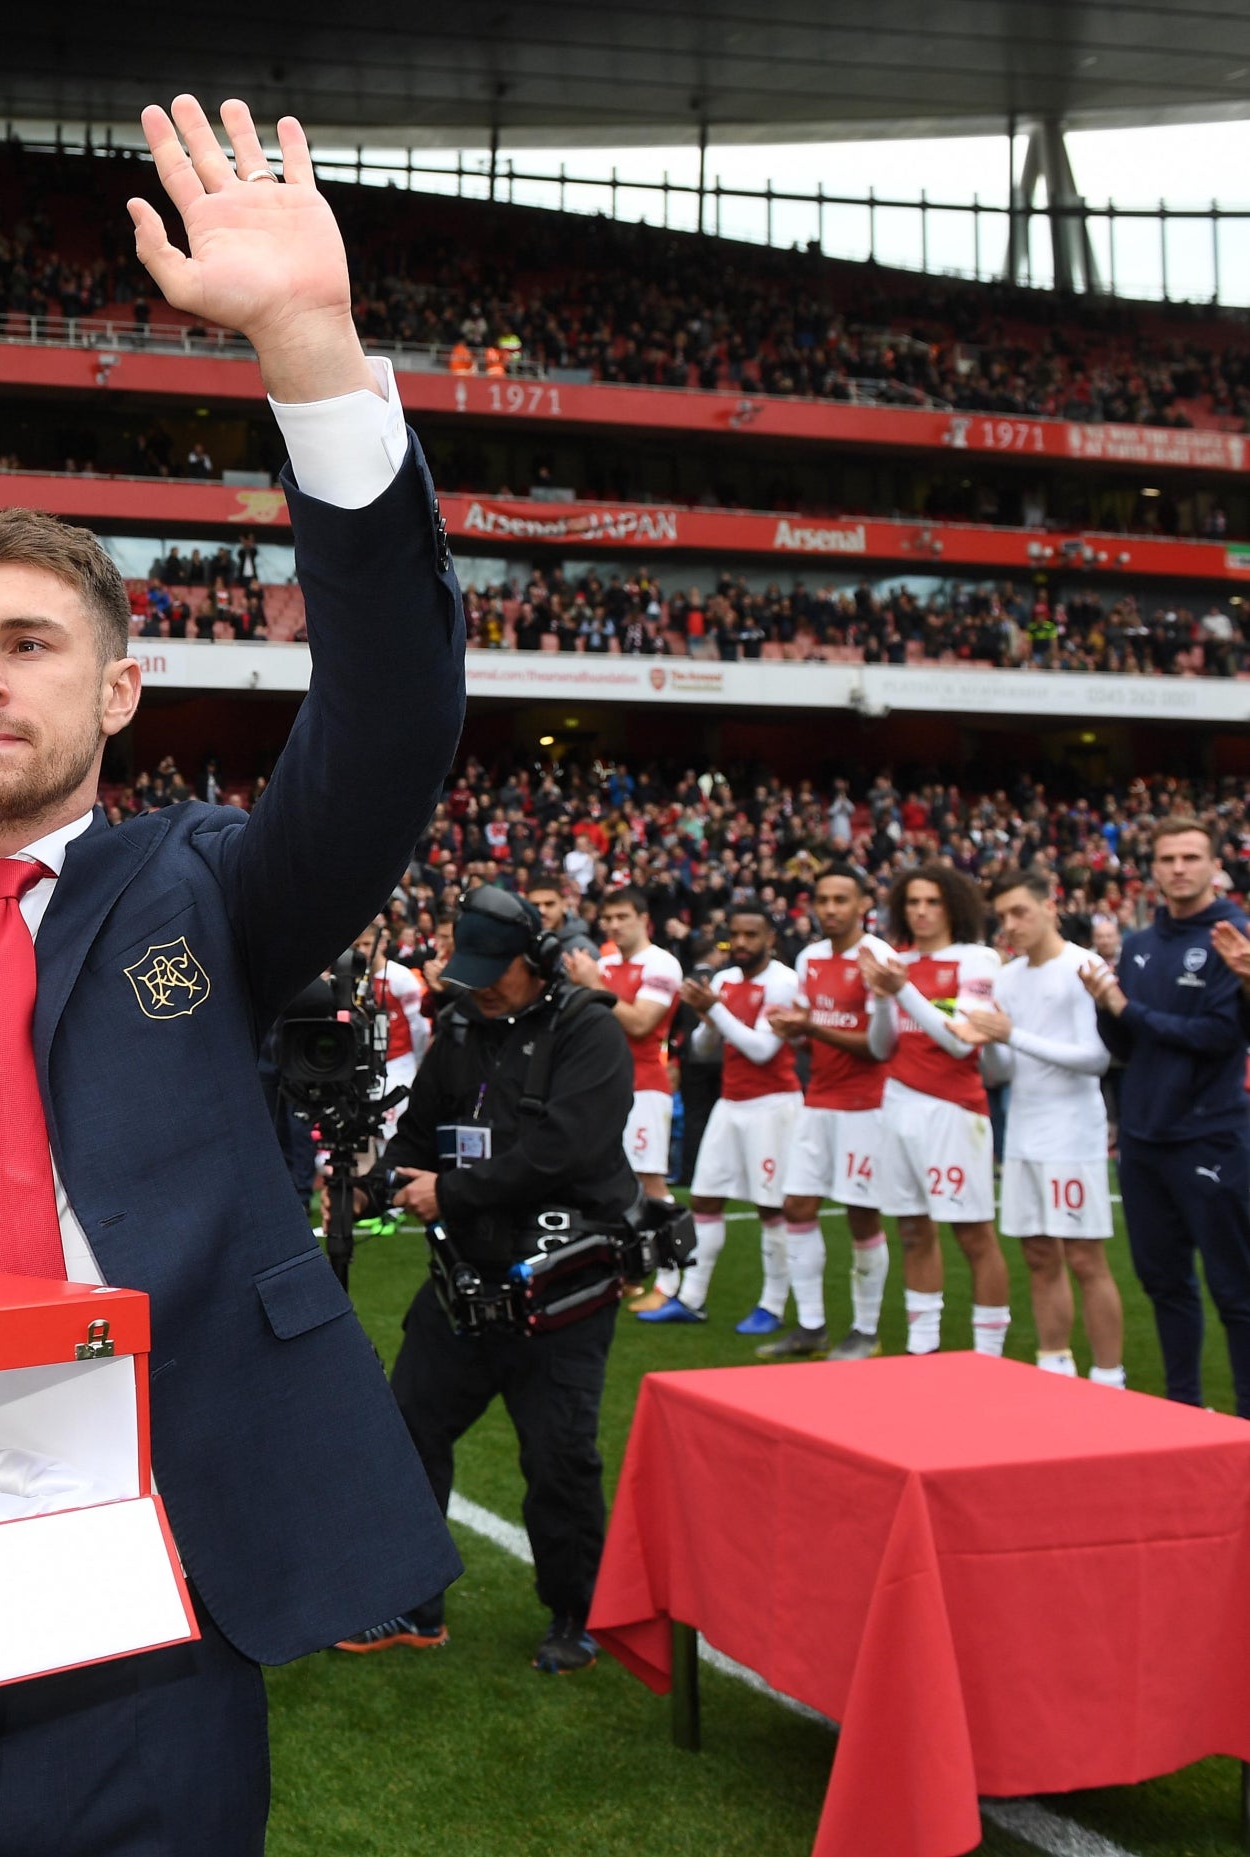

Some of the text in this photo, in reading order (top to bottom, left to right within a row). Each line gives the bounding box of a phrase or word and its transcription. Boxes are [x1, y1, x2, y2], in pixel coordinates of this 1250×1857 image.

[488, 383, 562, 415] 1971
[981, 420, 1045, 451] 1971
[579, 510, 678, 540] JAPAN
[773, 519, 867, 553] Arsenal
[635, 1128, 648, 1151] 5
[763, 1159, 776, 1182] 9
[847, 1153, 873, 1180] 14
[927, 1166, 965, 1196] 29
[1051, 1179, 1085, 1210] 10
